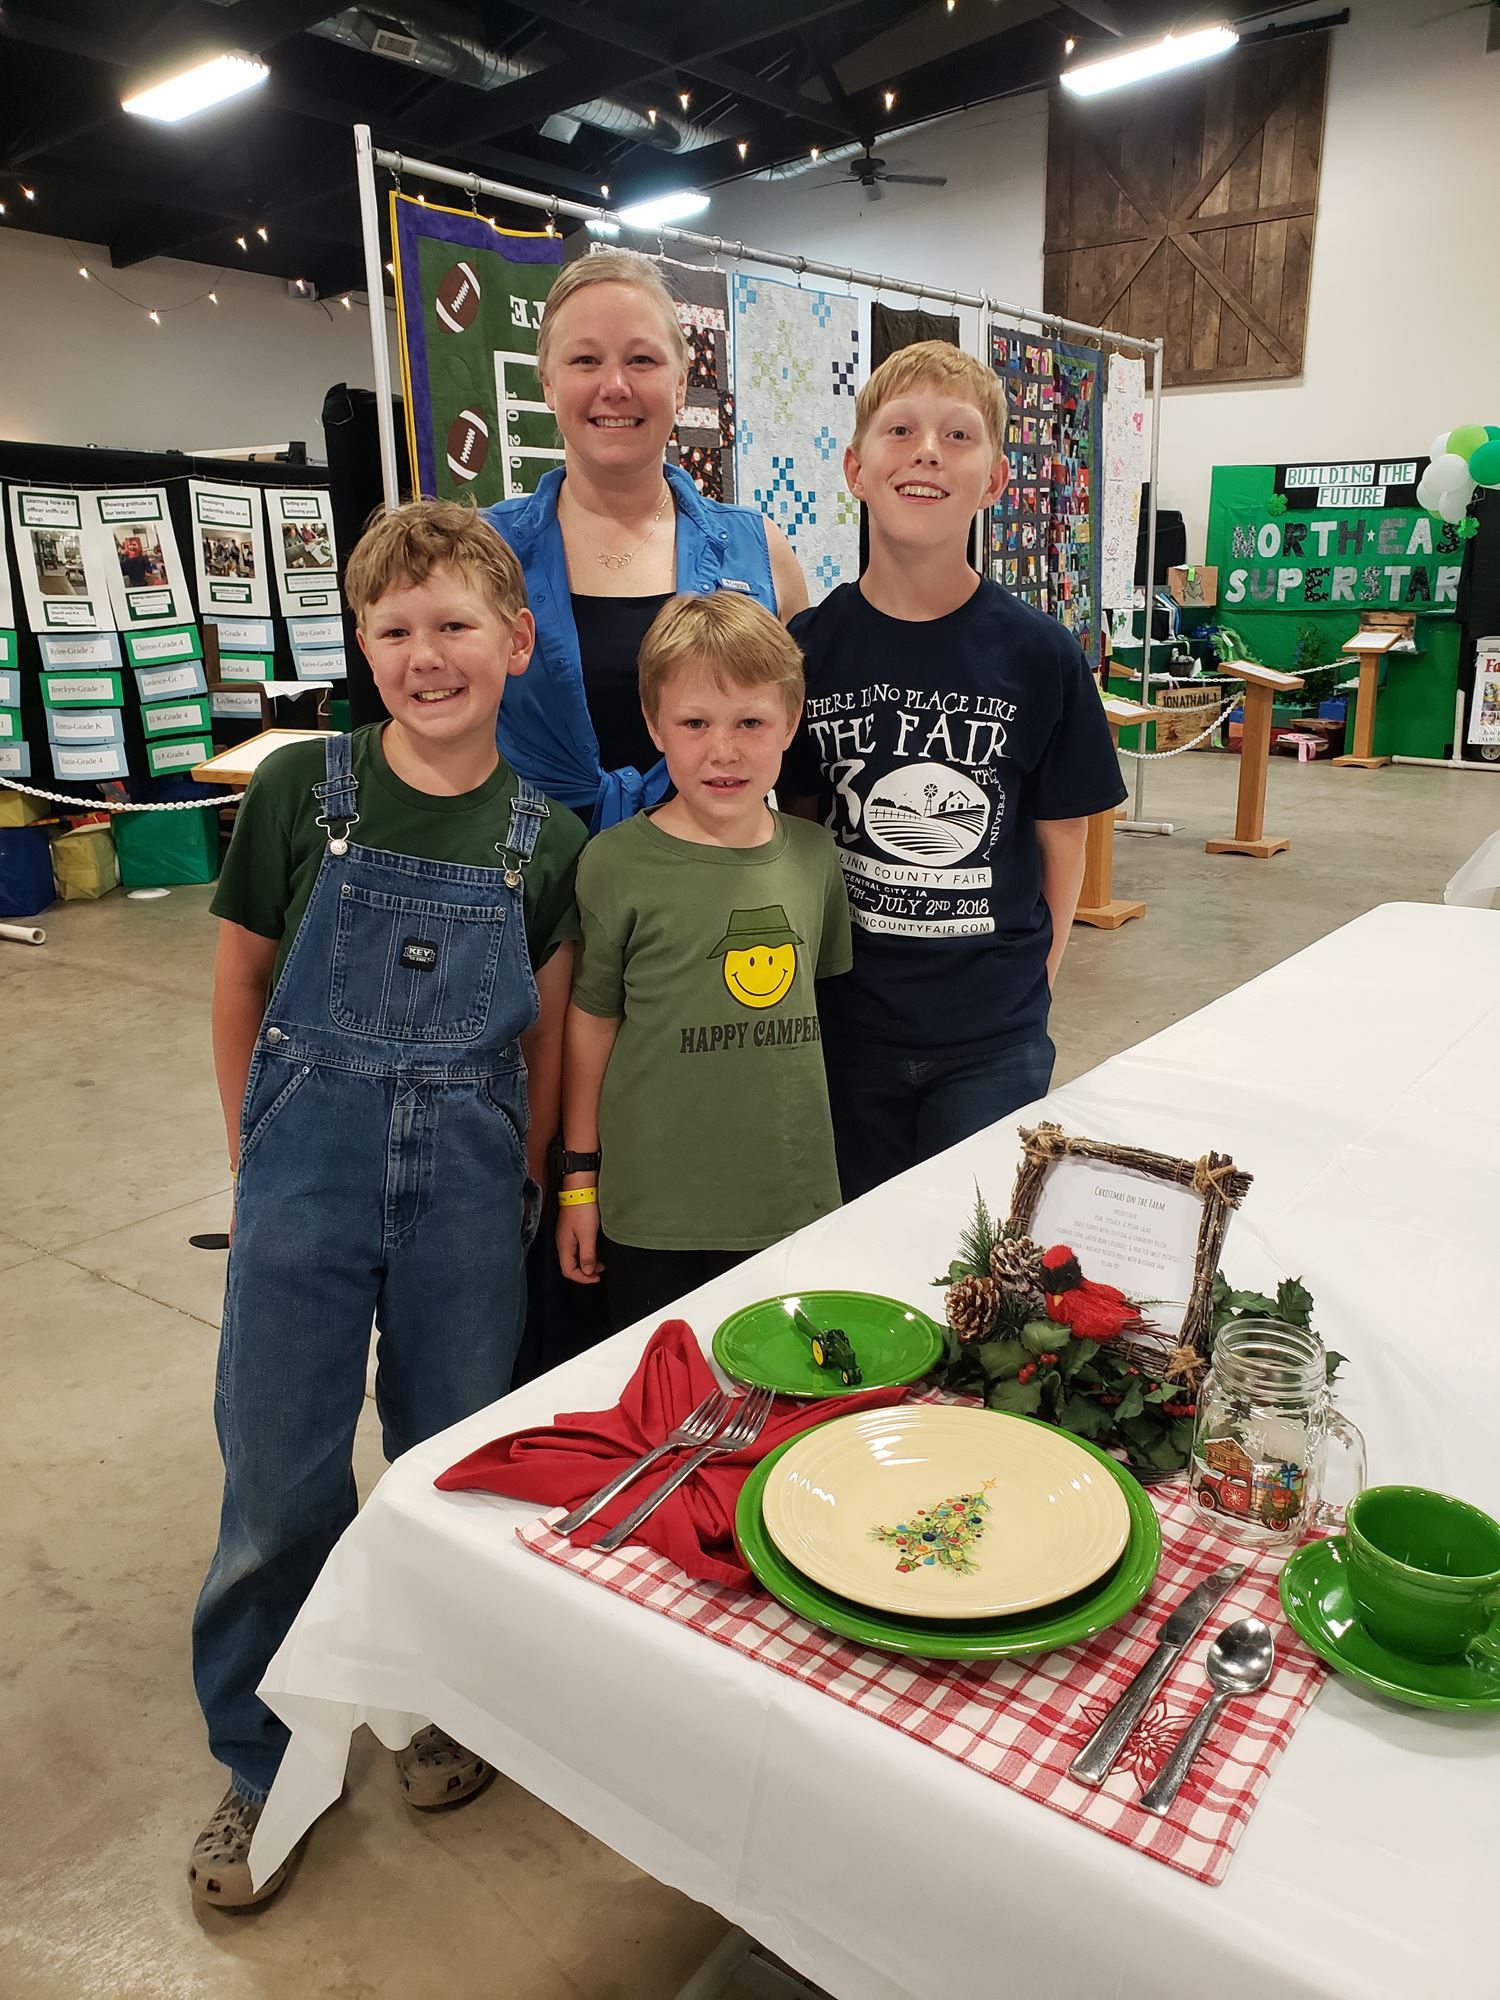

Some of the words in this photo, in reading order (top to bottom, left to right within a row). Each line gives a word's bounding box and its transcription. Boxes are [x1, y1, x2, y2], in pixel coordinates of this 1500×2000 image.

[1287, 466, 1372, 486] BUILDING
[1382, 464, 1414, 483] THE
[1319, 487, 1384, 506] FUTURE
[1232, 519, 1366, 558] NORTH
[1225, 565, 1462, 603] SUPERSTAR
[806, 693, 856, 719] THERE
[872, 683, 901, 702] NO
[903, 688, 969, 715] PLACE
[973, 695, 1018, 722] LIKE
[1163, 692, 1210, 708] JONATHAN
[807, 713, 877, 762] THE
[892, 710, 1012, 766] FAIR
[839, 852, 869, 872] LINN
[873, 865, 944, 885] COUNTY
[952, 872, 987, 885] FAIR
[844, 872, 882, 892] CENTRAL
[883, 885, 912, 898] CITY,
[915, 889, 928, 899] IA
[956, 898, 990, 916] 2018
[408, 946, 431, 957] KEY
[680, 1021, 750, 1054] HAPPY
[753, 1015, 821, 1048] CAMPER
